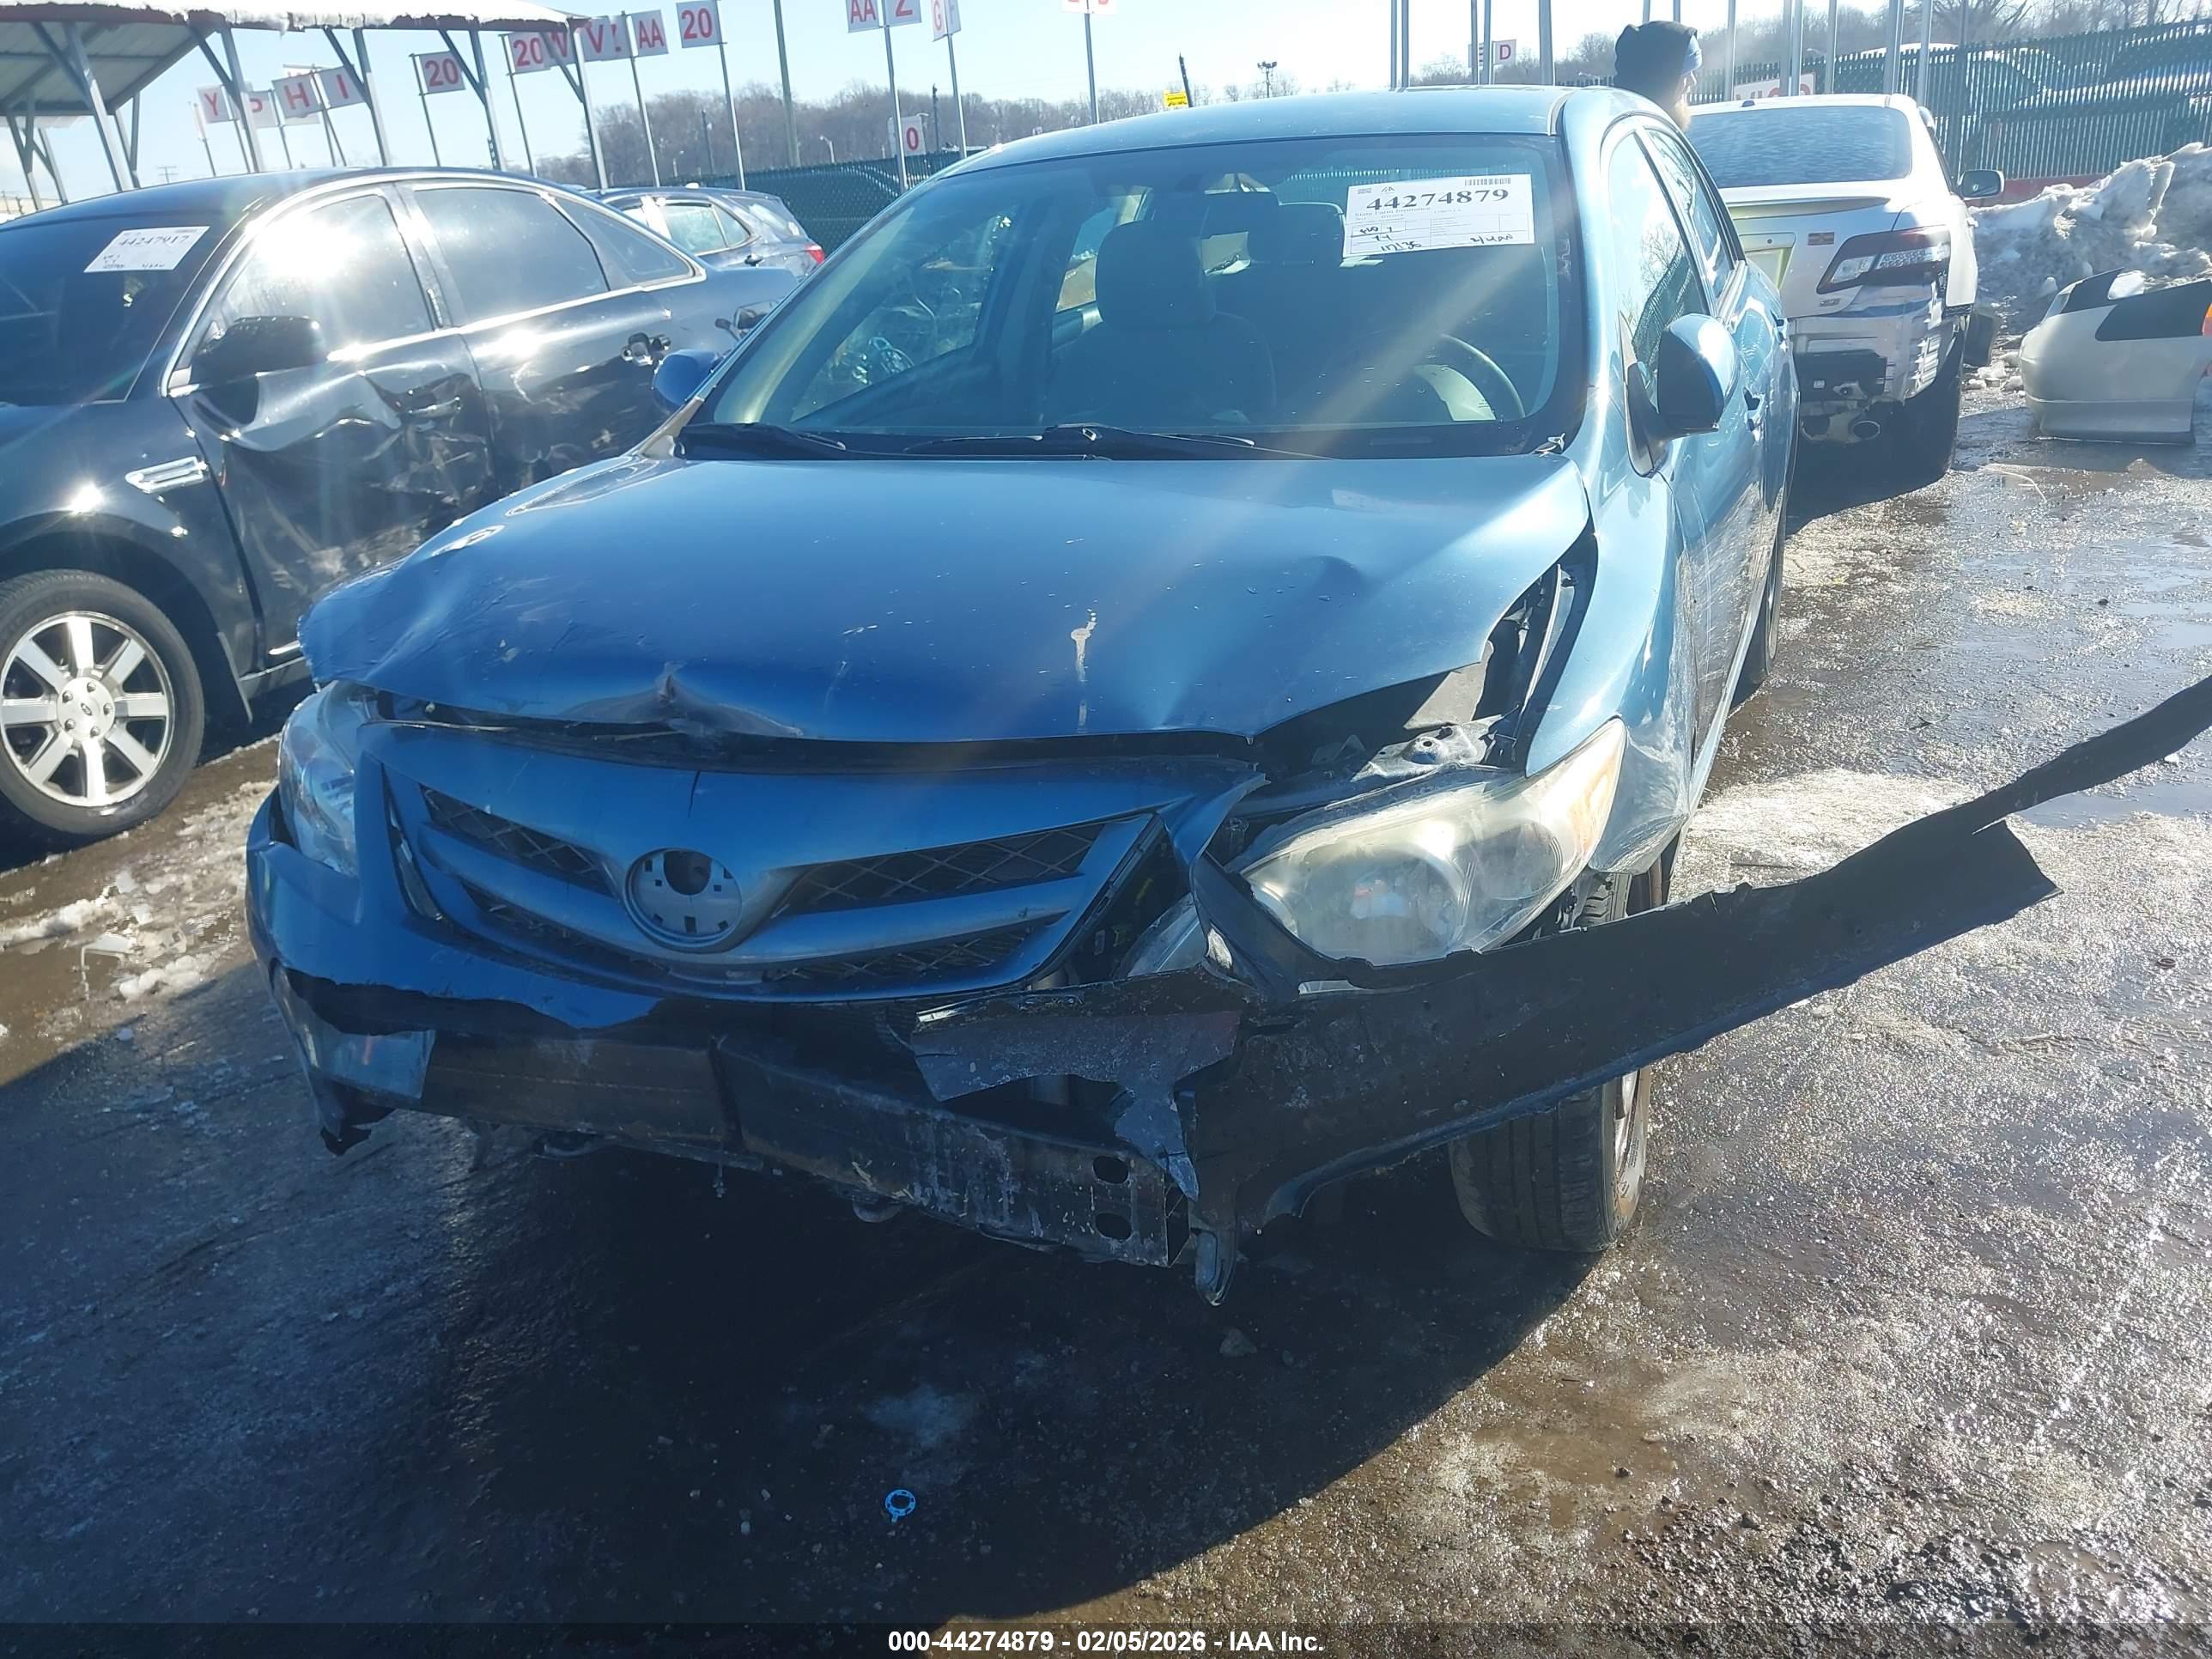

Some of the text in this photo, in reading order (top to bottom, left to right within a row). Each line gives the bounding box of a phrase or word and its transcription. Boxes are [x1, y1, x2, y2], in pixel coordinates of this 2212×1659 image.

[680, 7, 714, 40] 20
[850, 0, 877, 24] AA
[638, 18, 665, 49] AA
[512, 37, 544, 67] 20
[1498, 44, 1512, 61] D
[424, 58, 459, 88] 20
[204, 92, 218, 116] Y
[283, 82, 310, 110] H
[1365, 188, 1510, 211] 44274879
